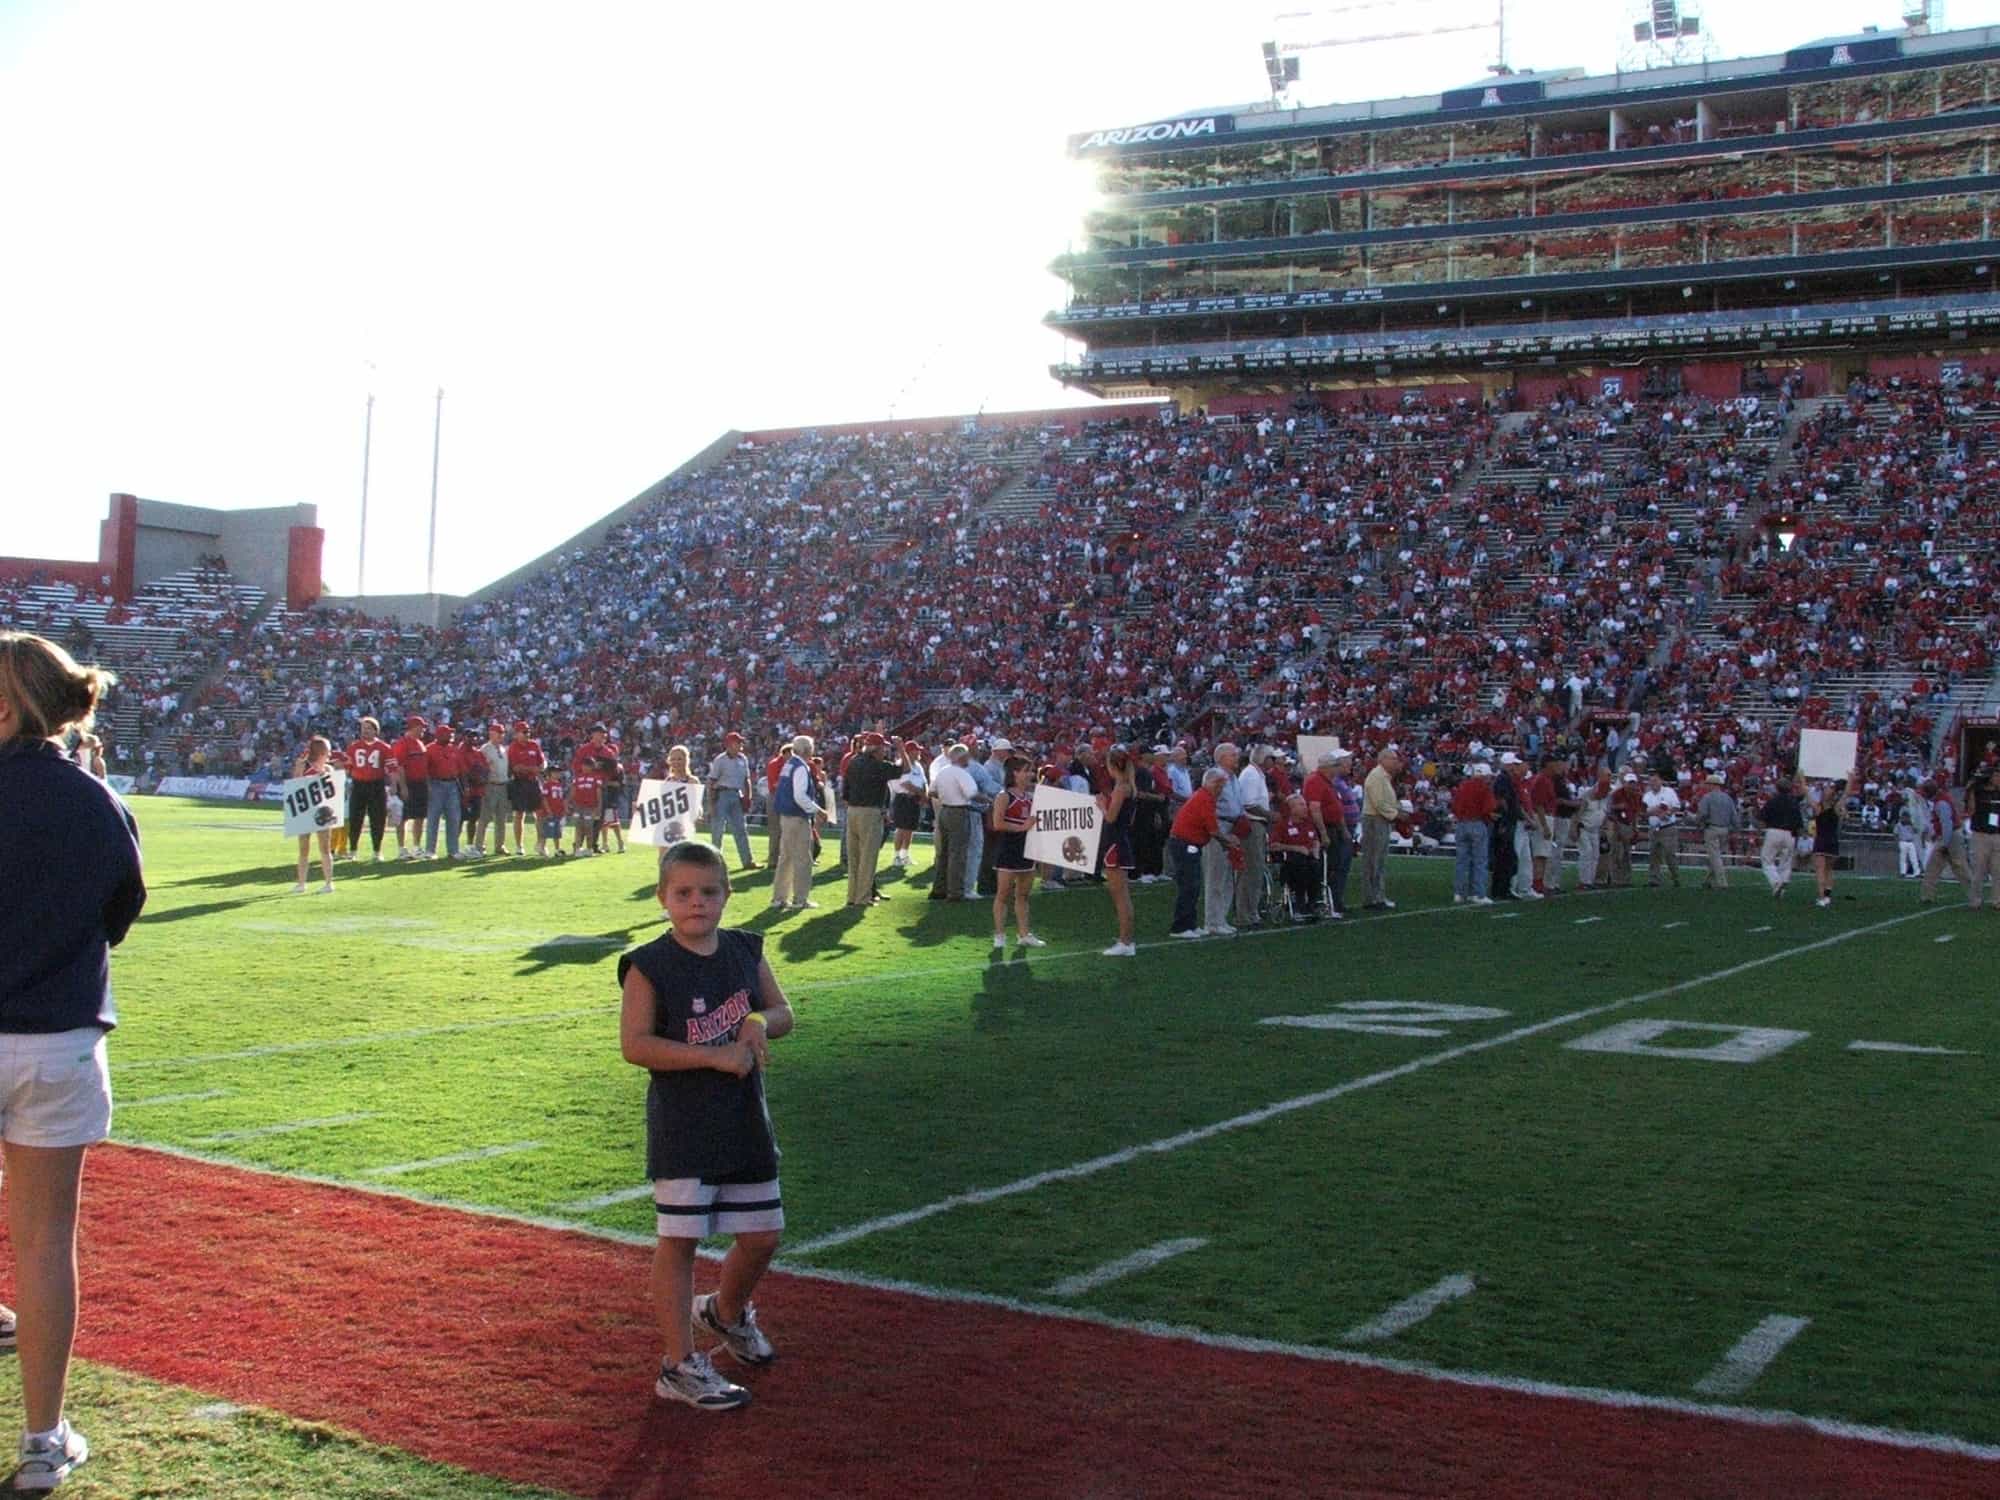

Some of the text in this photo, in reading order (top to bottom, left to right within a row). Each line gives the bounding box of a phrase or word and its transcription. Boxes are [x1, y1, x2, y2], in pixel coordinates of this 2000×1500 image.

[1080, 118, 1215, 148] ARIZONA
[1942, 367, 1961, 382] 22
[1603, 383, 1620, 396] 21
[354, 748, 380, 769] 64
[286, 775, 335, 818] 1965
[636, 786, 689, 828] 1955
[1035, 806, 1094, 832] EMERITUS
[686, 991, 752, 1046] ARIZON
